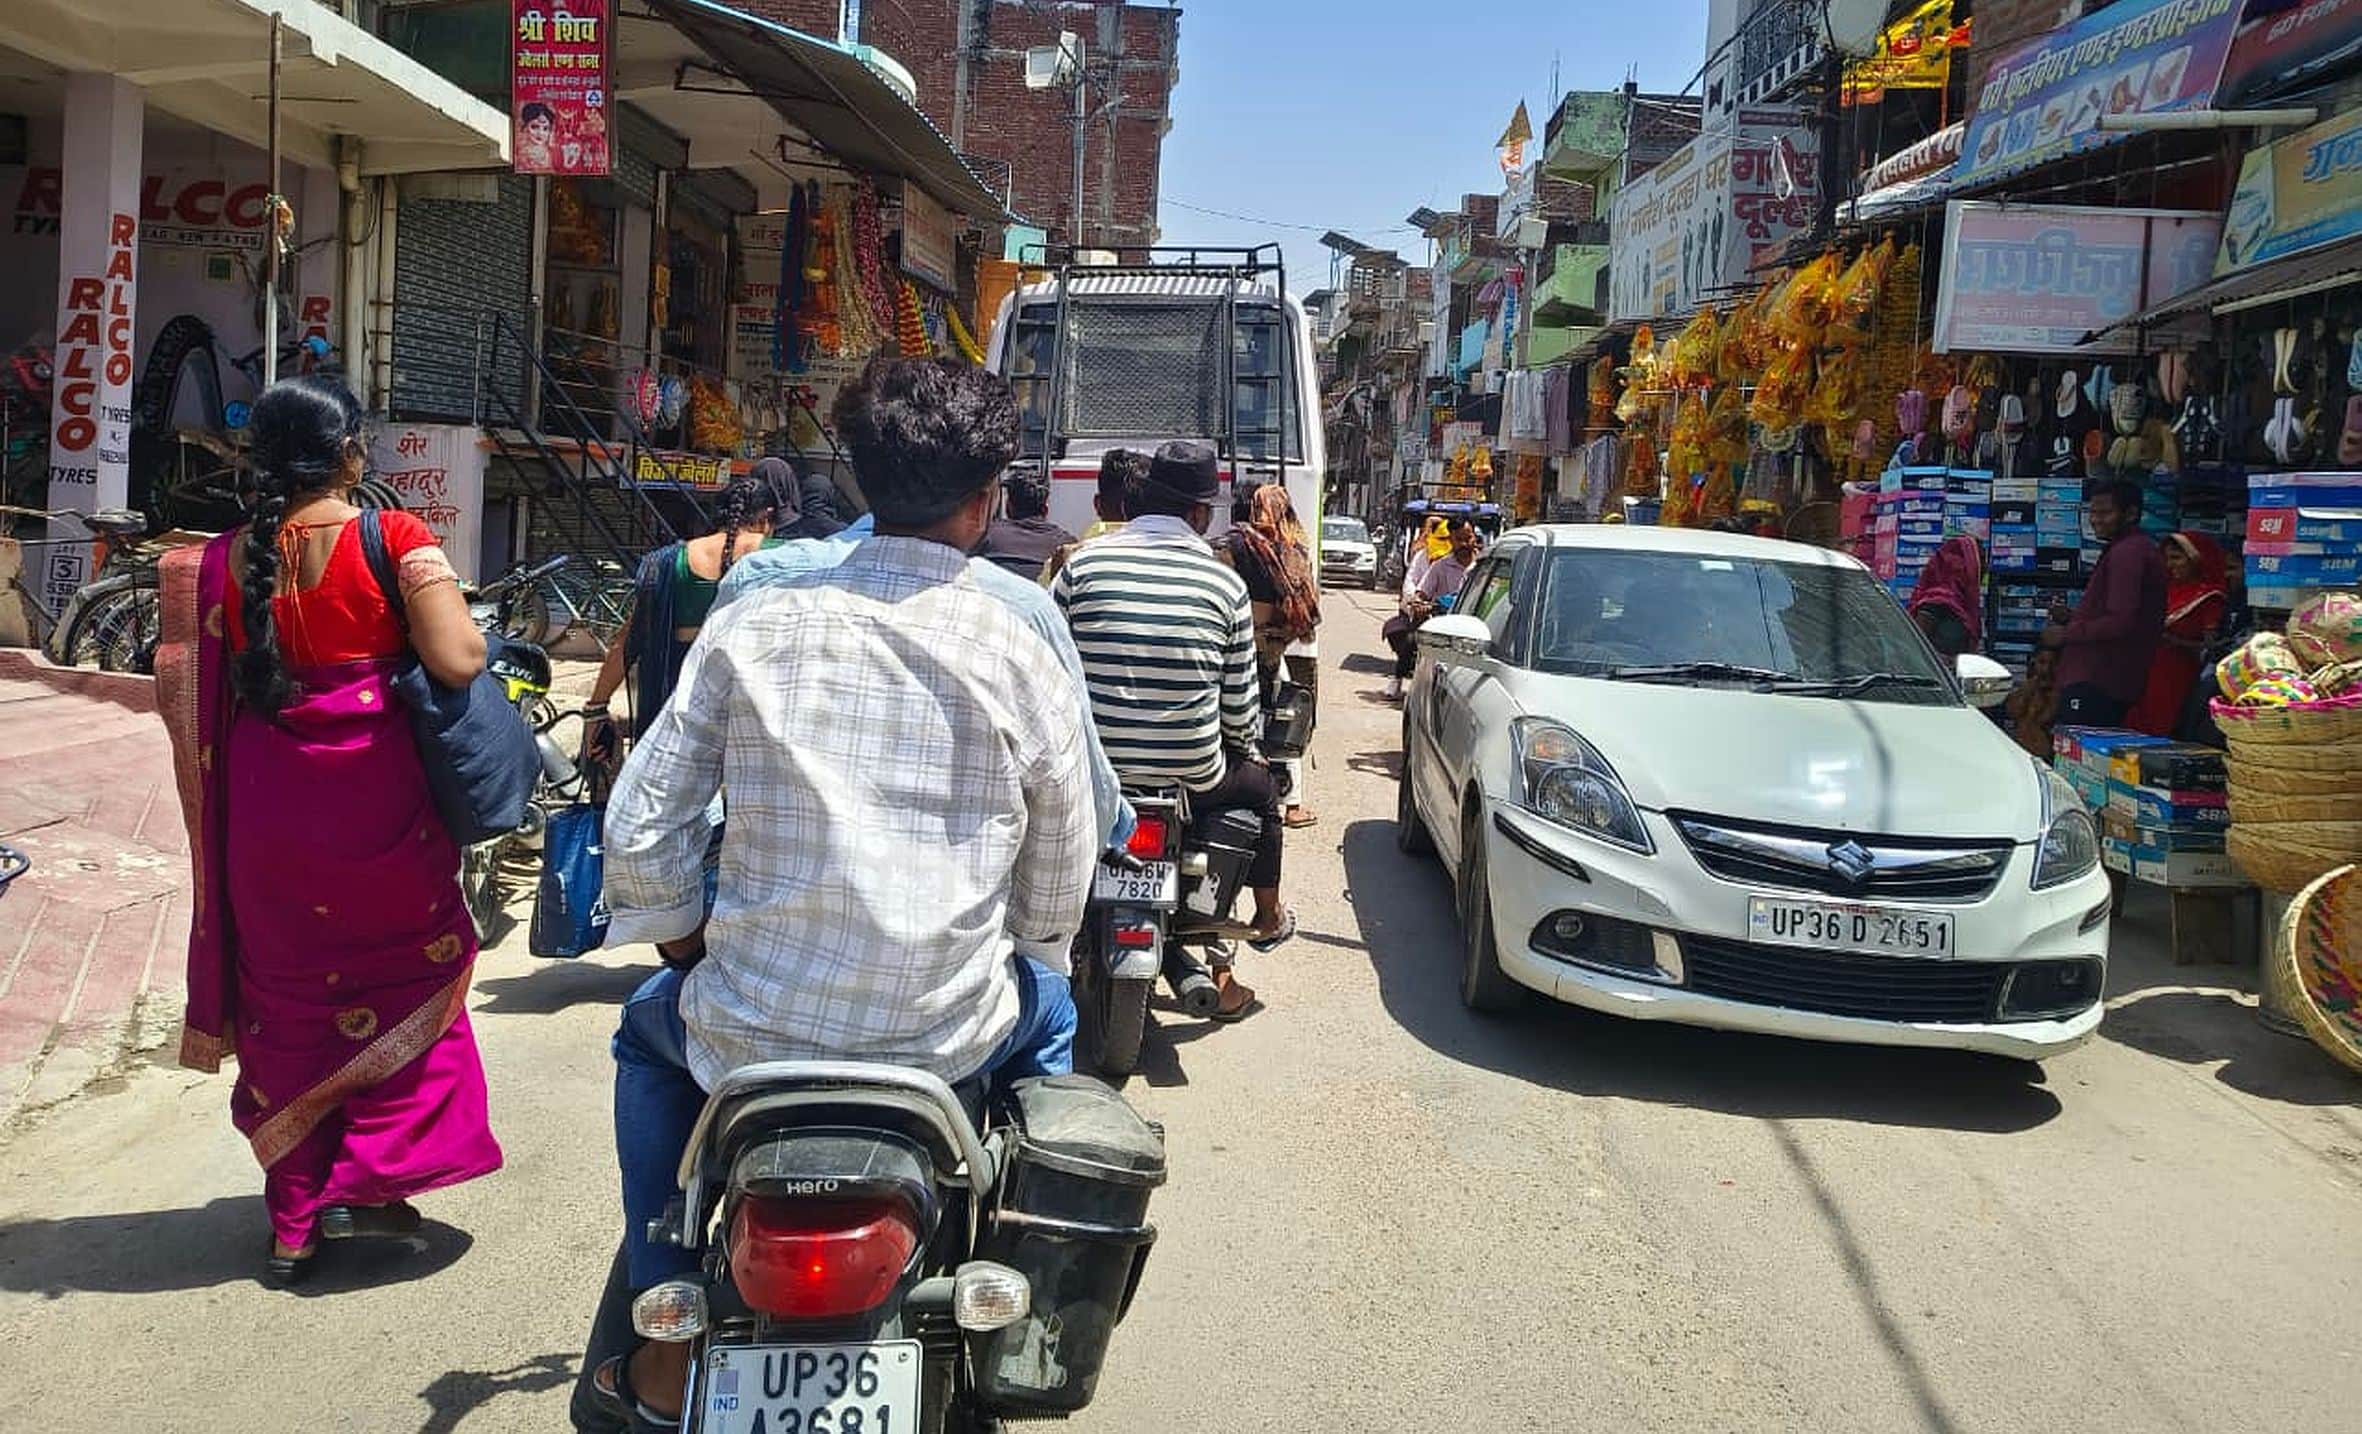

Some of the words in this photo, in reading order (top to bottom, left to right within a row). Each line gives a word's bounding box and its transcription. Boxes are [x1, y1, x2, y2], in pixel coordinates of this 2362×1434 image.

[518, 10, 546, 42] श्री
[552, 10, 598, 42] शिव
[106, 213, 137, 386] RALCO
[57, 277, 105, 452] RALCO
[50, 465, 98, 485] TYRES
[1117, 880, 1163, 899] 7820
[1772, 906, 1841, 940] UP36
[1852, 914, 1867, 943] D
[1879, 917, 1947, 951] 2651
[762, 1350, 879, 1399] UP36
[750, 1404, 891, 1434] A3681
